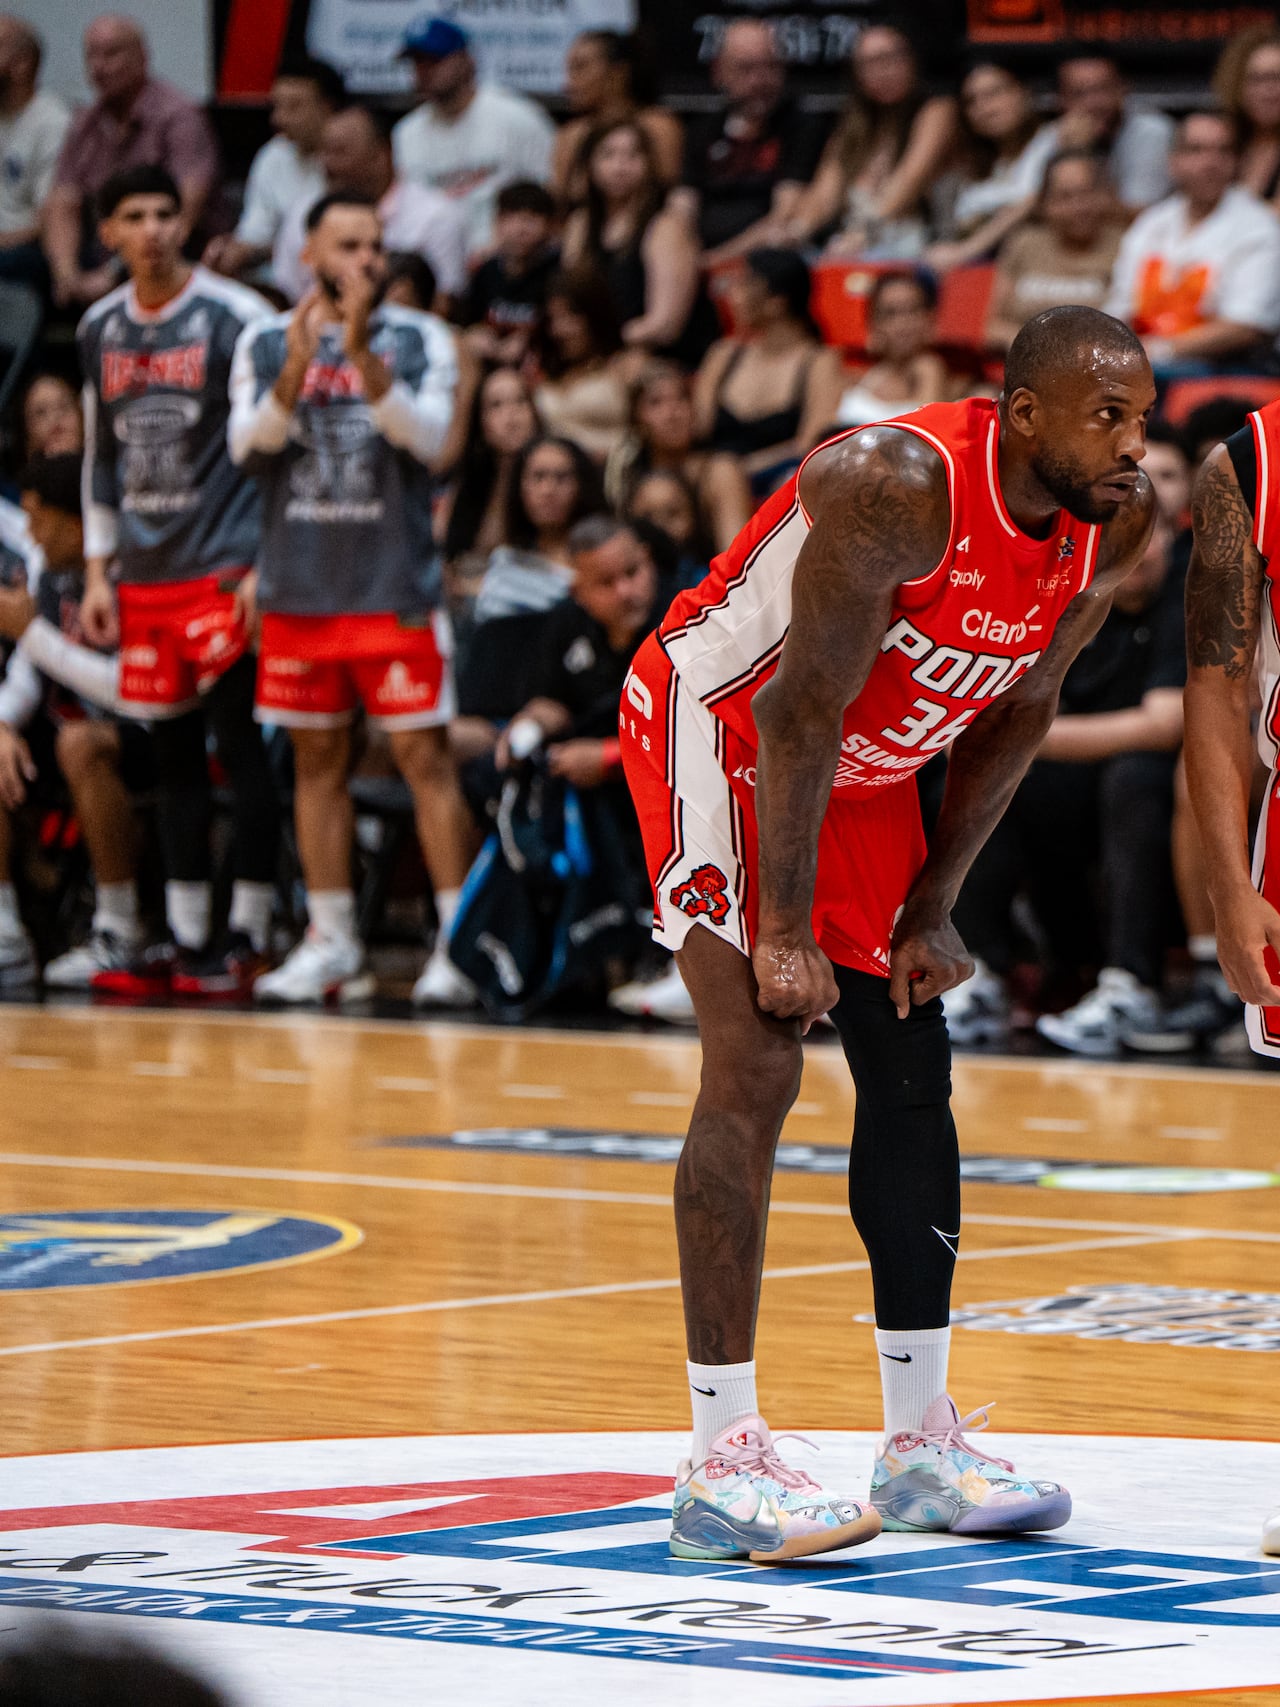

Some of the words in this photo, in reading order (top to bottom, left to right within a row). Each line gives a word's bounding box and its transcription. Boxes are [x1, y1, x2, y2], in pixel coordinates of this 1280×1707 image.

[961, 608, 1027, 644] Claro
[881, 615, 1042, 700] PONC
[880, 697, 978, 751] 36
[0, 1585, 280, 1615] PARK
[239, 1608, 357, 1623] &
[133, 1559, 605, 1609] Truck
[562, 1598, 1197, 1660] Rental
